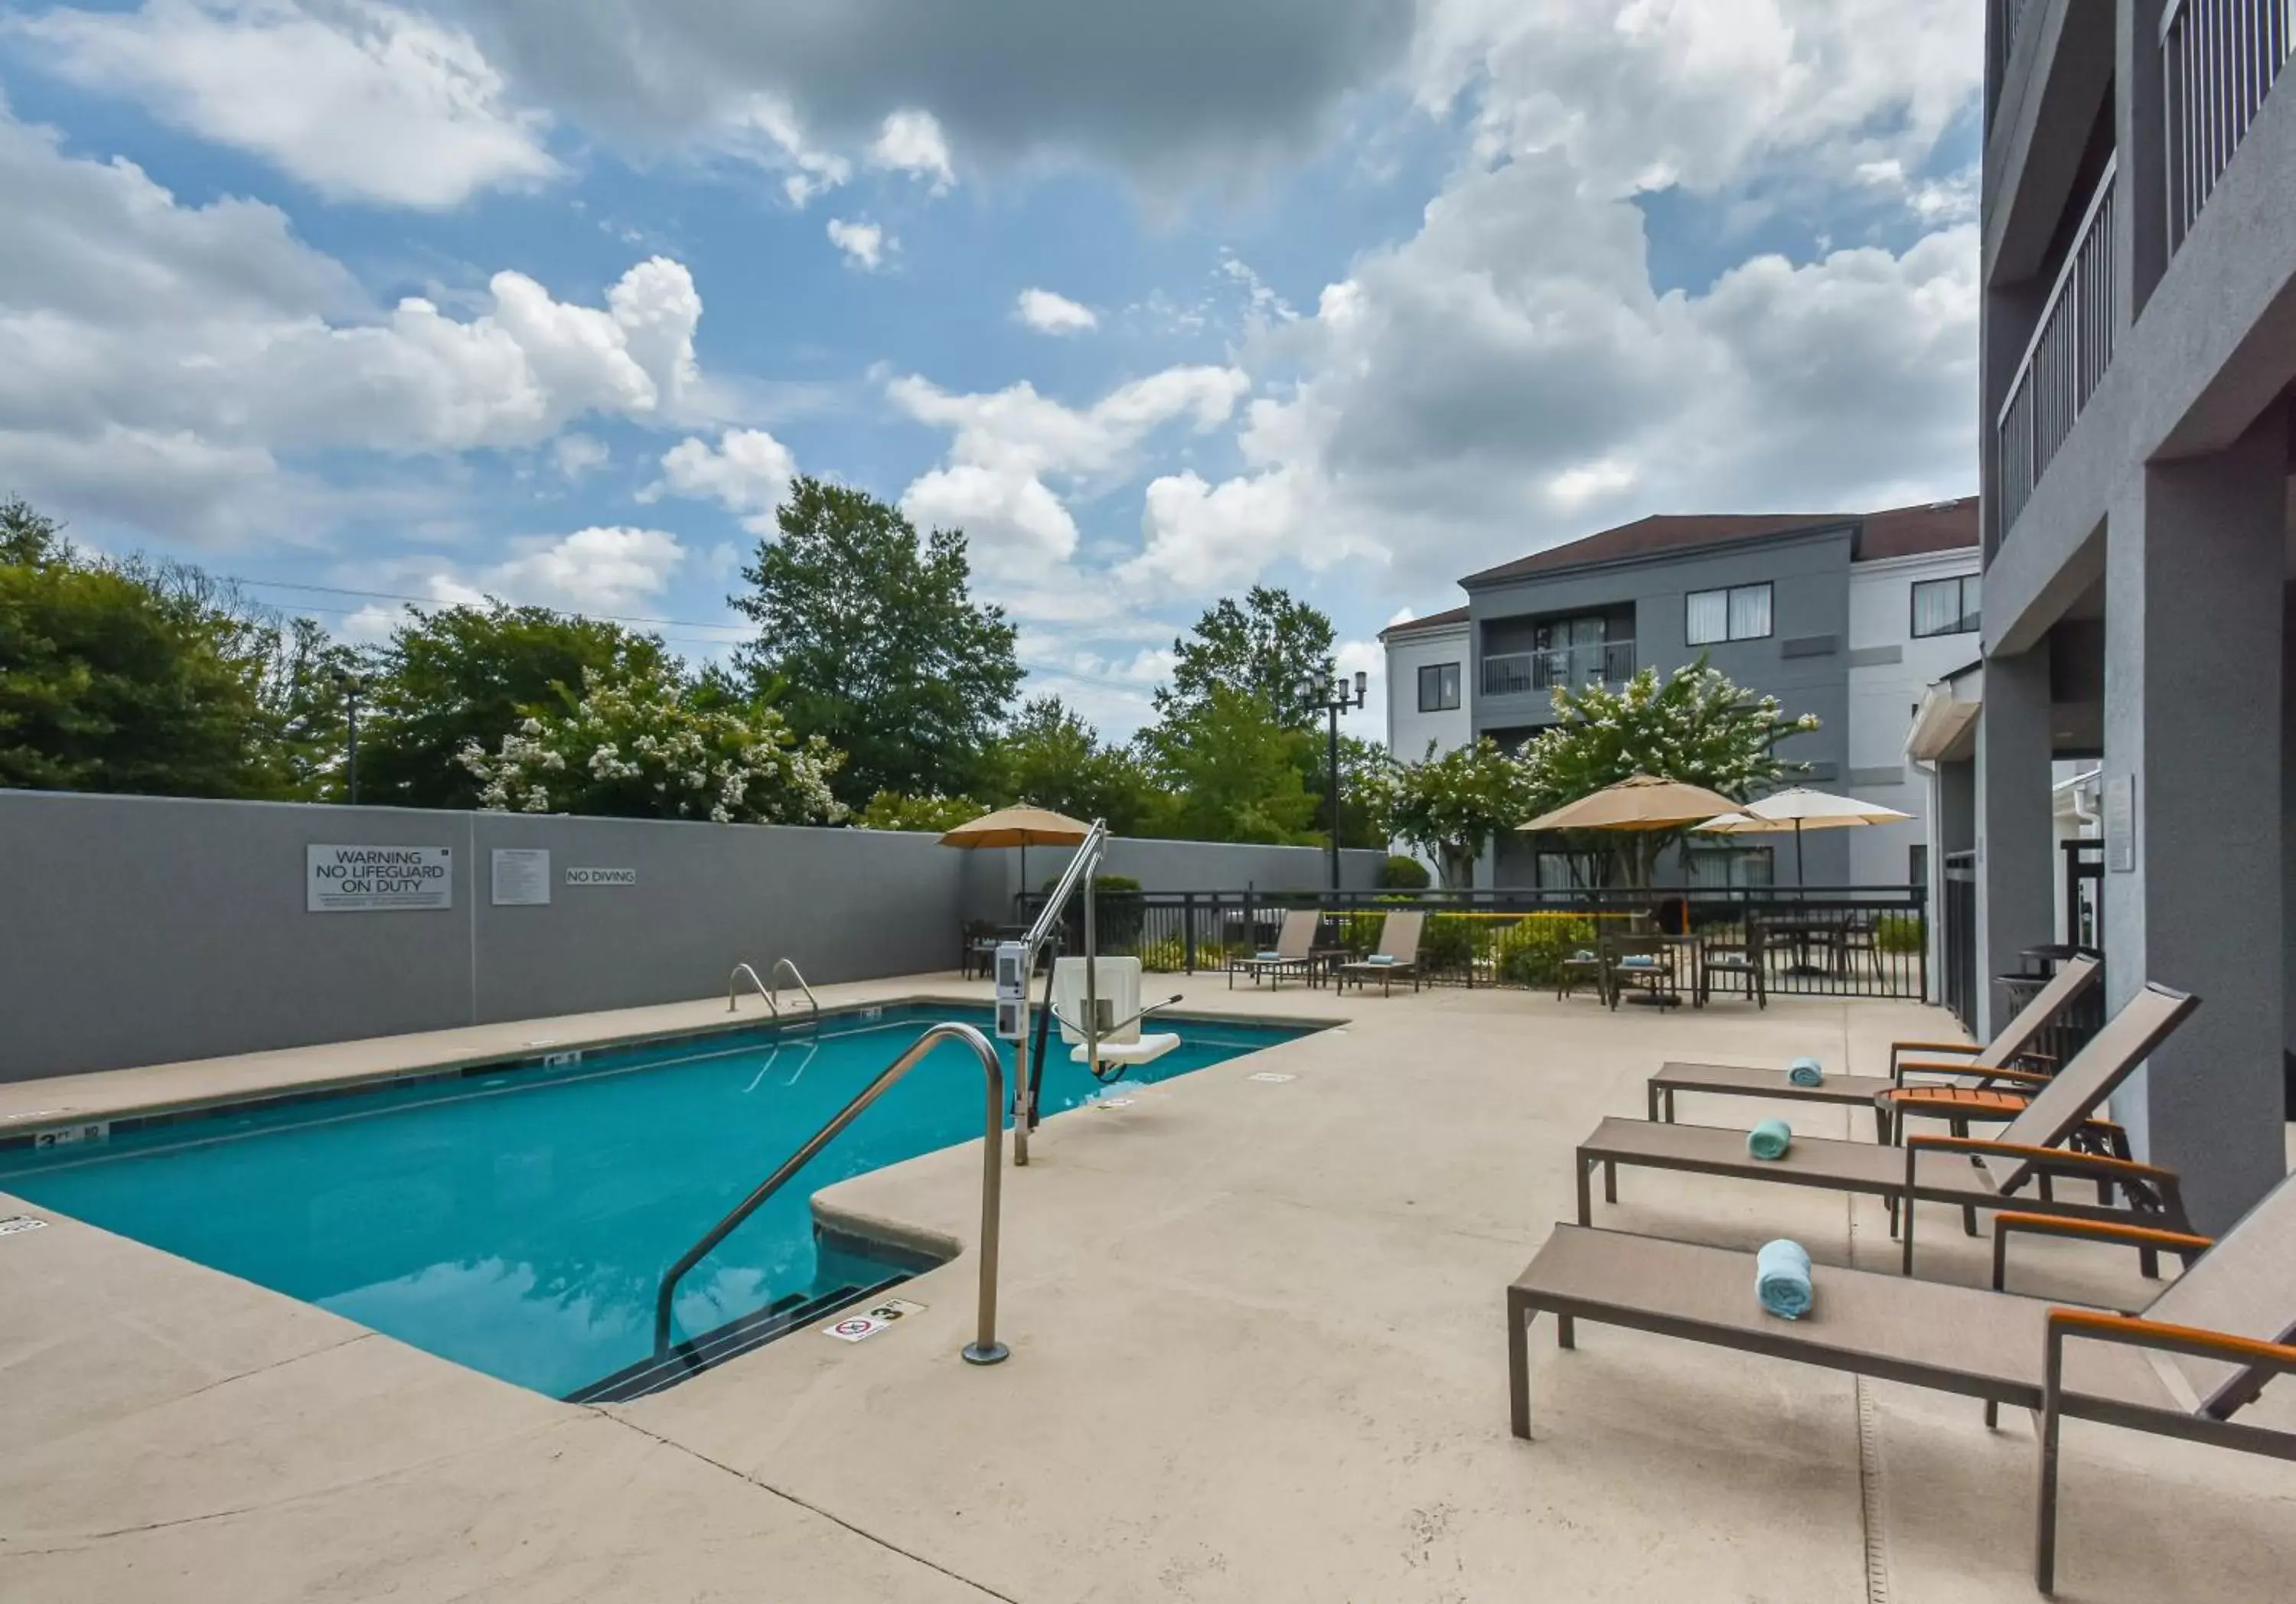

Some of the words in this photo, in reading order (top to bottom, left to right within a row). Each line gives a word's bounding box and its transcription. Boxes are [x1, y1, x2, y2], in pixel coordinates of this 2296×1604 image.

[336, 849, 422, 864] WARNING
[316, 865, 347, 879] NO
[352, 866, 444, 879] LIFEGUARD
[567, 870, 589, 882] NO
[592, 871, 634, 882] DIVING
[341, 879, 370, 893] ON
[377, 879, 422, 892] DUTY
[870, 1307, 904, 1320] 3
